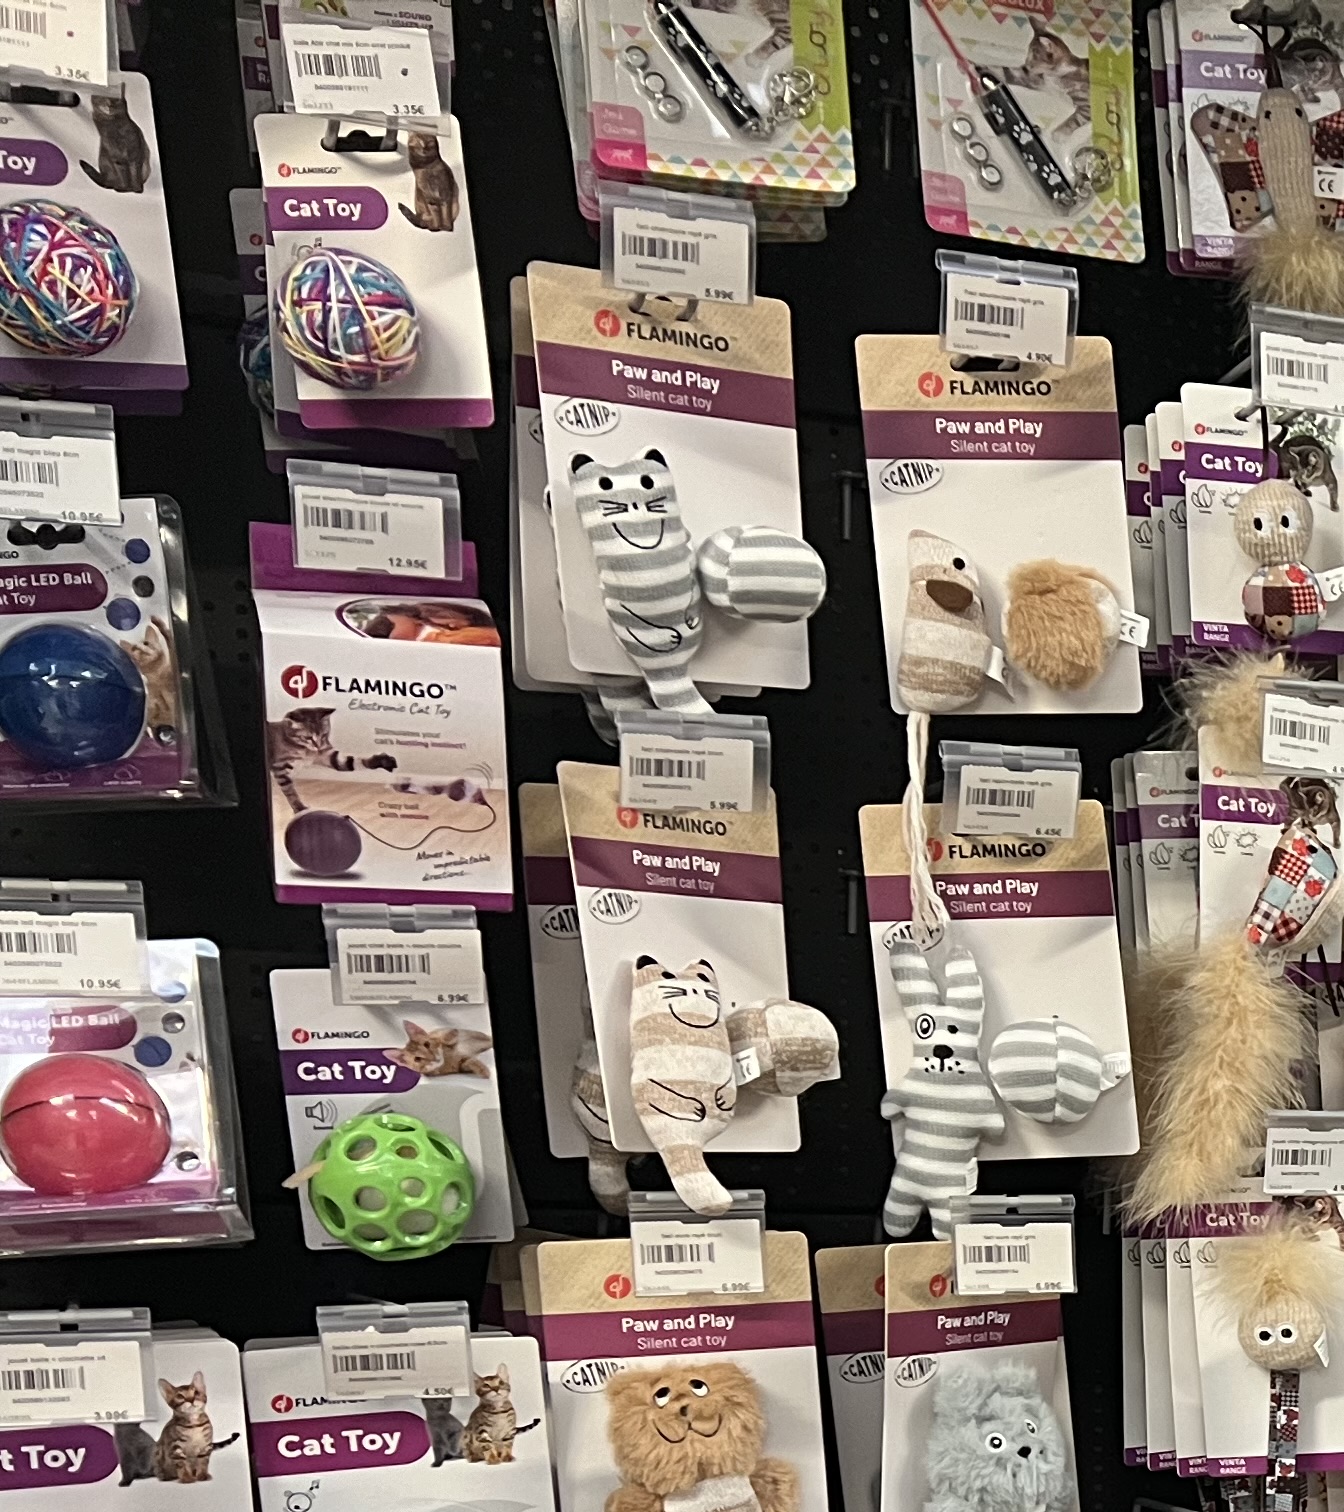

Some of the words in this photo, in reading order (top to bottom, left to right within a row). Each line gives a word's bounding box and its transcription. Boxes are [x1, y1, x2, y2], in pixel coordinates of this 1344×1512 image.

[1200, 62, 1232, 78] Cat
[1234, 61, 1267, 84] Toy
[393, 104, 425, 114] 3.35€
[284, 199, 321, 218] Cat
[323, 201, 361, 221] Toy
[705, 287, 733, 300] 5.99€
[626, 322, 729, 352] FLAMINGO
[612, 360, 647, 380] Paw
[652, 366, 681, 386] and
[686, 370, 720, 395] Play
[950, 380, 1051, 396] FLAMINGO
[627, 385, 664, 403] Silent
[670, 393, 689, 407] cat
[693, 395, 712, 413] toy
[565, 403, 609, 428] CATNIP
[935, 418, 970, 433] Paw
[975, 419, 1005, 434] and
[1009, 418, 1042, 438] Play
[951, 440, 988, 453] Silent
[992, 440, 1012, 453] cat
[1016, 442, 1035, 455] toy
[890, 462, 933, 488] CATNIP
[1201, 453, 1232, 470] Cat
[1236, 455, 1263, 477] Toy
[61, 511, 103, 522] 10.95€
[389, 557, 427, 569] 12.95€
[14, 593, 35, 606] Toy
[322, 676, 443, 698] FLAMINGO
[349, 699, 405, 712] Electronic
[410, 703, 430, 715] Cat
[436, 705, 450, 718] Toy
[710, 801, 738, 810] 5.99€
[1218, 796, 1247, 812] Cat
[1249, 797, 1276, 817] Toy
[643, 814, 727, 836] FLAMINGO
[1035, 827, 1061, 837] 6.45€
[949, 843, 1046, 859] FLAMINGO
[632, 850, 663, 868] Paw
[665, 855, 690, 870] and
[692, 856, 720, 876] Play
[646, 872, 676, 888] Silent
[680, 876, 696, 890] cat
[699, 879, 714, 893] toy
[936, 880, 969, 894] Paw
[973, 881, 1002, 894] and
[1007, 879, 1039, 896] Play
[597, 892, 633, 916] CATNIP
[950, 901, 985, 913] Silent
[989, 902, 1010, 913] cat
[1013, 901, 1032, 914] toy
[79, 978, 122, 989] 10.95€
[298, 1062, 344, 1082] Cat
[349, 1061, 396, 1084] Toy
[1206, 1211, 1234, 1227] Cat
[1238, 1211, 1270, 1228] Toy
[621, 1315, 658, 1333] Paw
[664, 1314, 694, 1331] and
[699, 1313, 734, 1333] Play
[937, 1314, 960, 1330] Paw
[963, 1313, 985, 1328] and
[987, 1311, 1010, 1328] Play
[638, 1335, 677, 1350] Silent
[681, 1336, 702, 1348] cat
[706, 1335, 727, 1350] toy
[901, 1359, 935, 1381] CATNIP
[277, 1432, 335, 1457] Cat
[339, 1429, 400, 1456] Toy
[21, 1444, 86, 1472] Toy
[1220, 1465, 1247, 1474] RANGE
